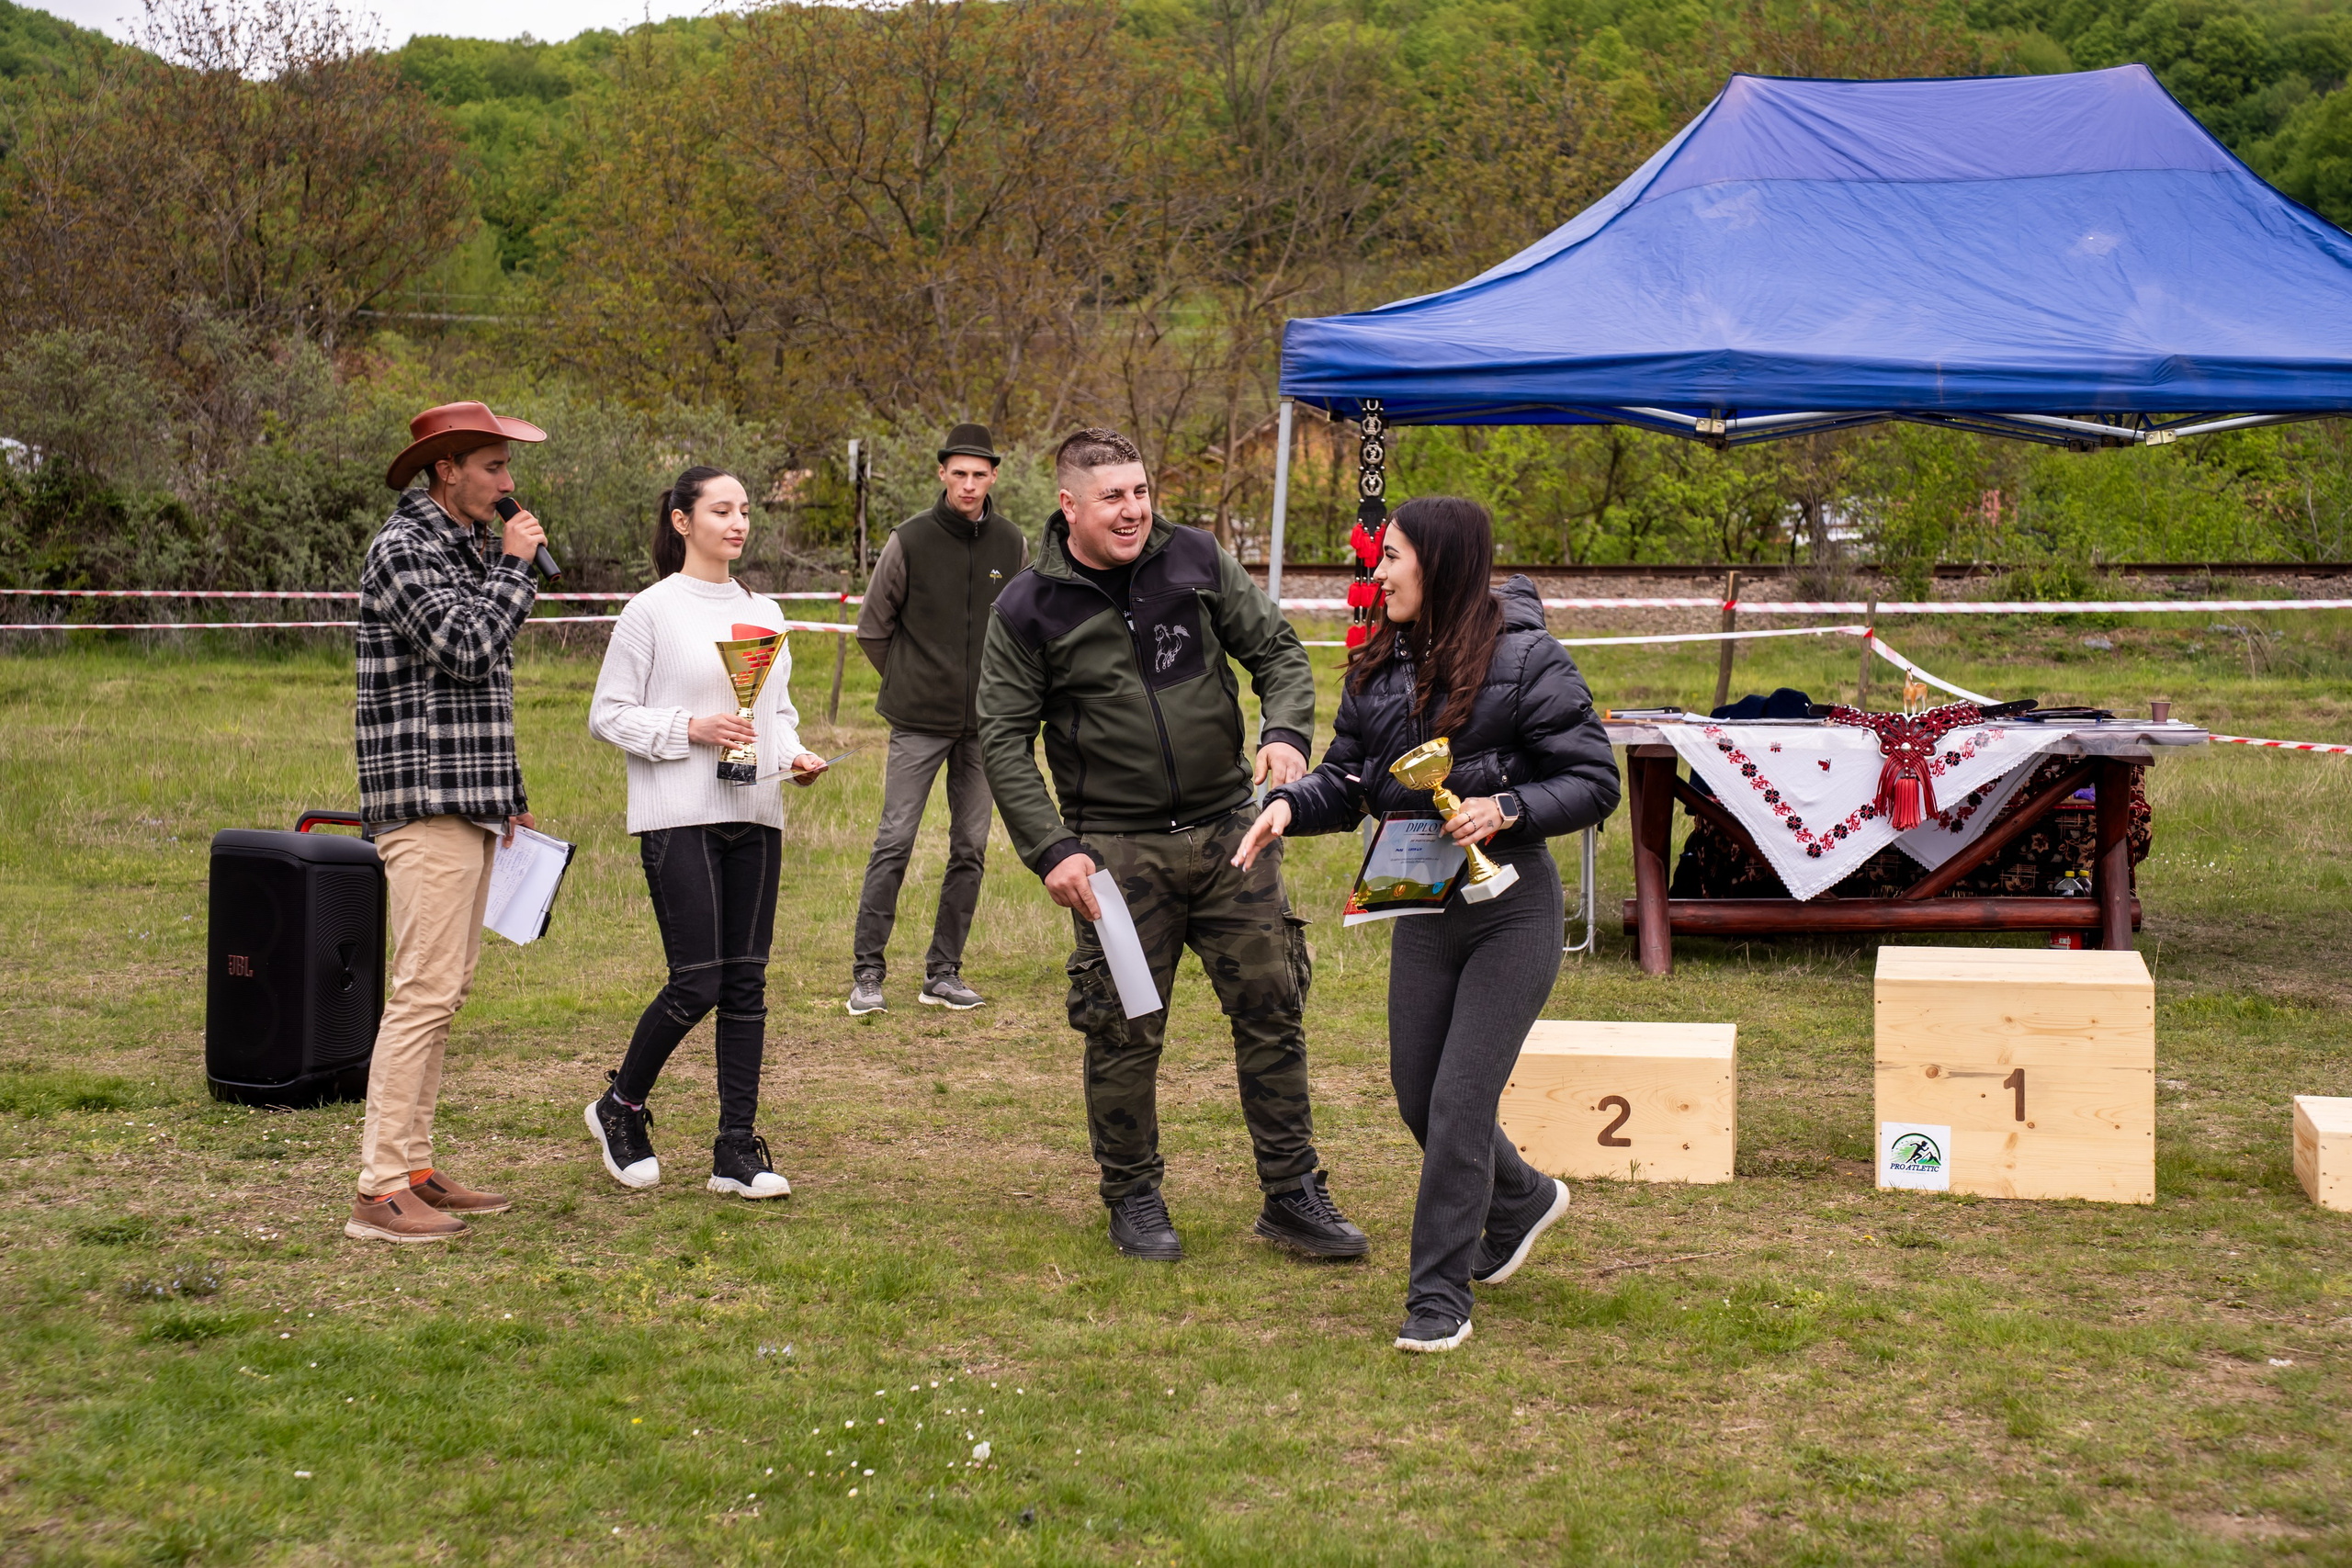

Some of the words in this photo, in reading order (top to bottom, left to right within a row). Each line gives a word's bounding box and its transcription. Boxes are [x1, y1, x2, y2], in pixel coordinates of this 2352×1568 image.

[228, 954, 254, 977] JBL
[2003, 1068, 2025, 1122] 1
[1597, 1095, 1632, 1147] 2
[1905, 1164, 1939, 1172] ATLETIC
